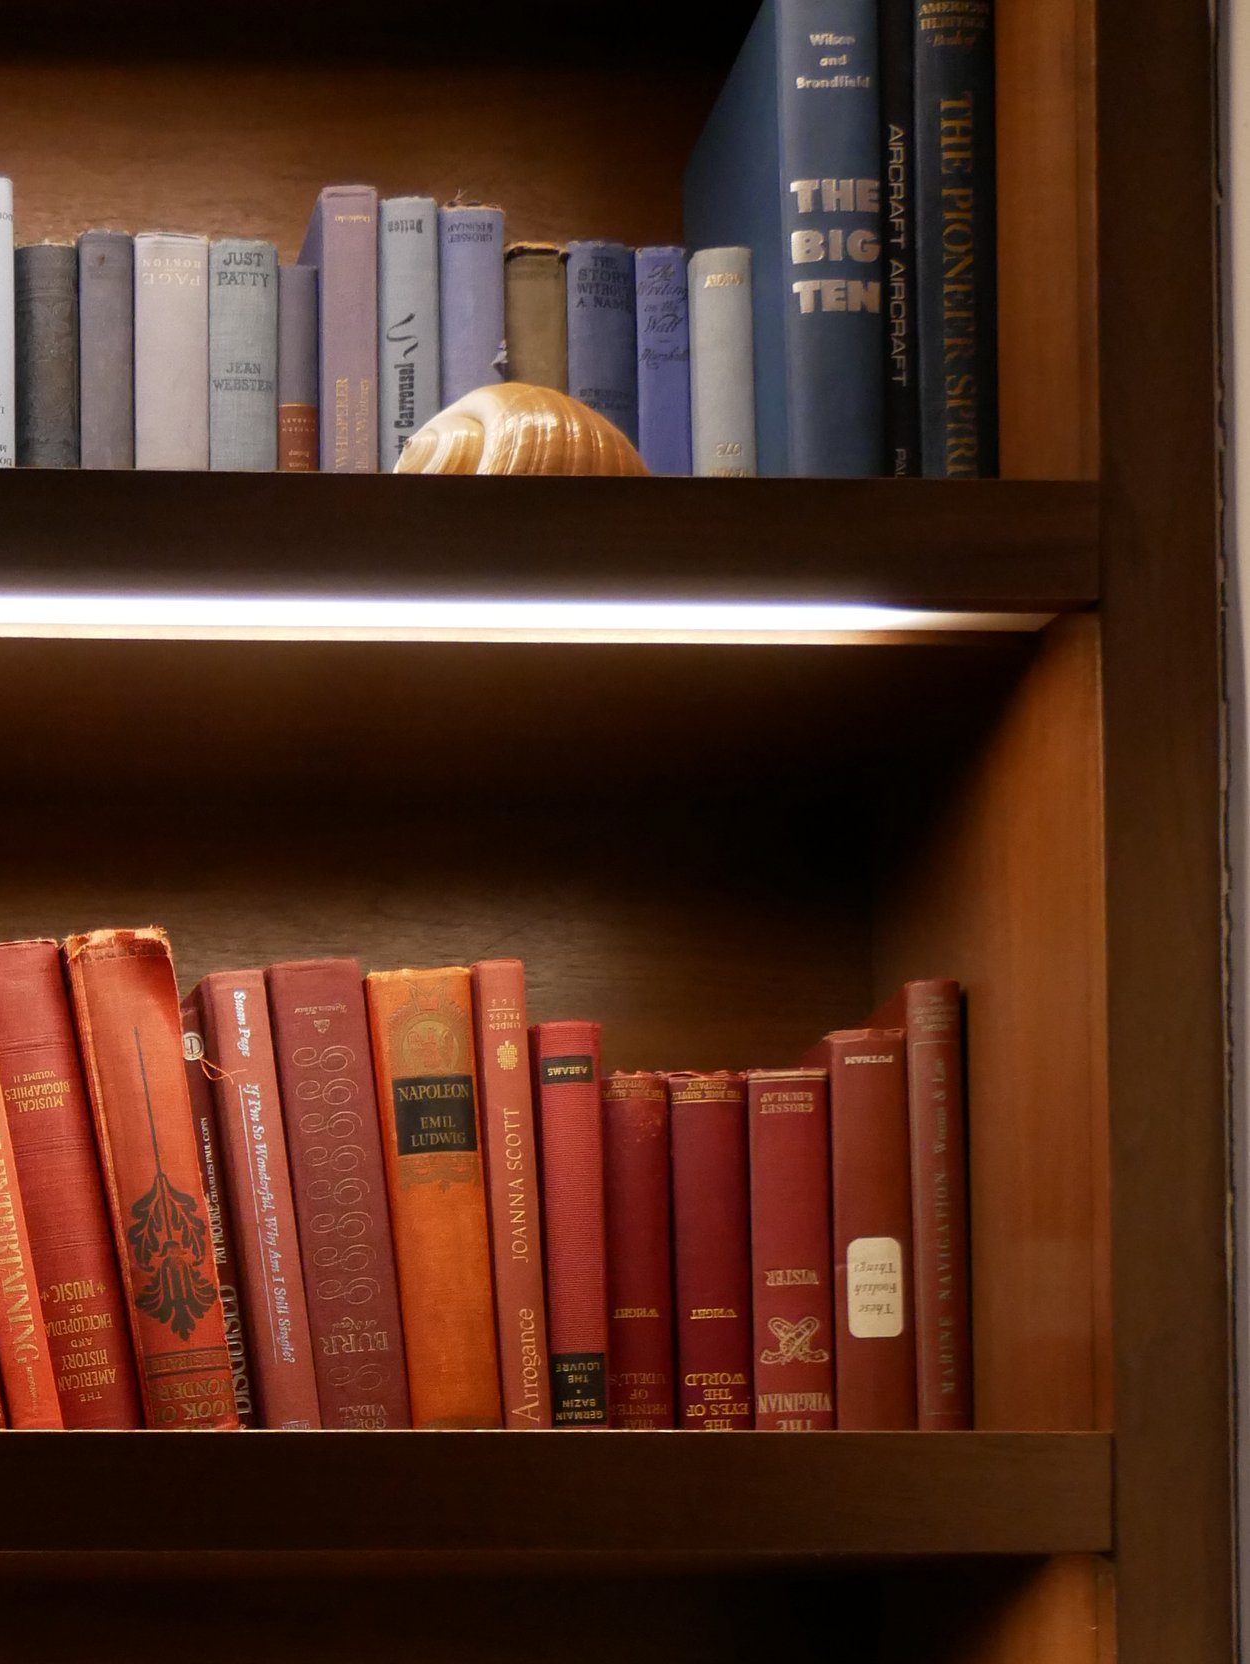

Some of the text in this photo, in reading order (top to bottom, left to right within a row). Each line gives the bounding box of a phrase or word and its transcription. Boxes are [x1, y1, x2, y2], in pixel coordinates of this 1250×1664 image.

[810, 33, 855, 45] Wilson
[820, 55, 846, 66] and
[790, 179, 880, 213] THE
[791, 229, 880, 264] BIG
[223, 252, 264, 267] JUST
[889, 124, 907, 386] AIRCRAFT AIRCRAFT
[217, 272, 269, 288] PATTY
[792, 281, 880, 314] TEN
[548, 1067, 588, 1076] ABRAMS
[5, 1080, 70, 1100] BIOGRAPHIES
[397, 1084, 469, 1101] NAPOLEON
[19, 1096, 63, 1112] MUSICAL
[421, 1116, 456, 1129] EMIL
[411, 1132, 465, 1146] LUDWIG
[504, 1109, 540, 1421] Arrogance JOANNA SCOTT
[853, 1263, 896, 1273] Things
[765, 1270, 819, 1286] WISTER
[50, 1280, 94, 1300] MUSIC
[614, 1308, 659, 1318] WRIGHT
[690, 1309, 737, 1319] WRIGHT
[858, 1304, 893, 1314] These
[71, 1337, 92, 1347] AND
[61, 1349, 108, 1370] HISTORY
[556, 1362, 600, 1371] LOUVRE
[57, 1368, 116, 1391] AMERICAN
[568, 1375, 589, 1383] THE
[685, 1373, 746, 1385] WORLD
[78, 1393, 102, 1401] THE
[703, 1389, 732, 1400] THE
[563, 1399, 596, 1407] BAZIN
[759, 1393, 832, 1414] VIRGINIAN
